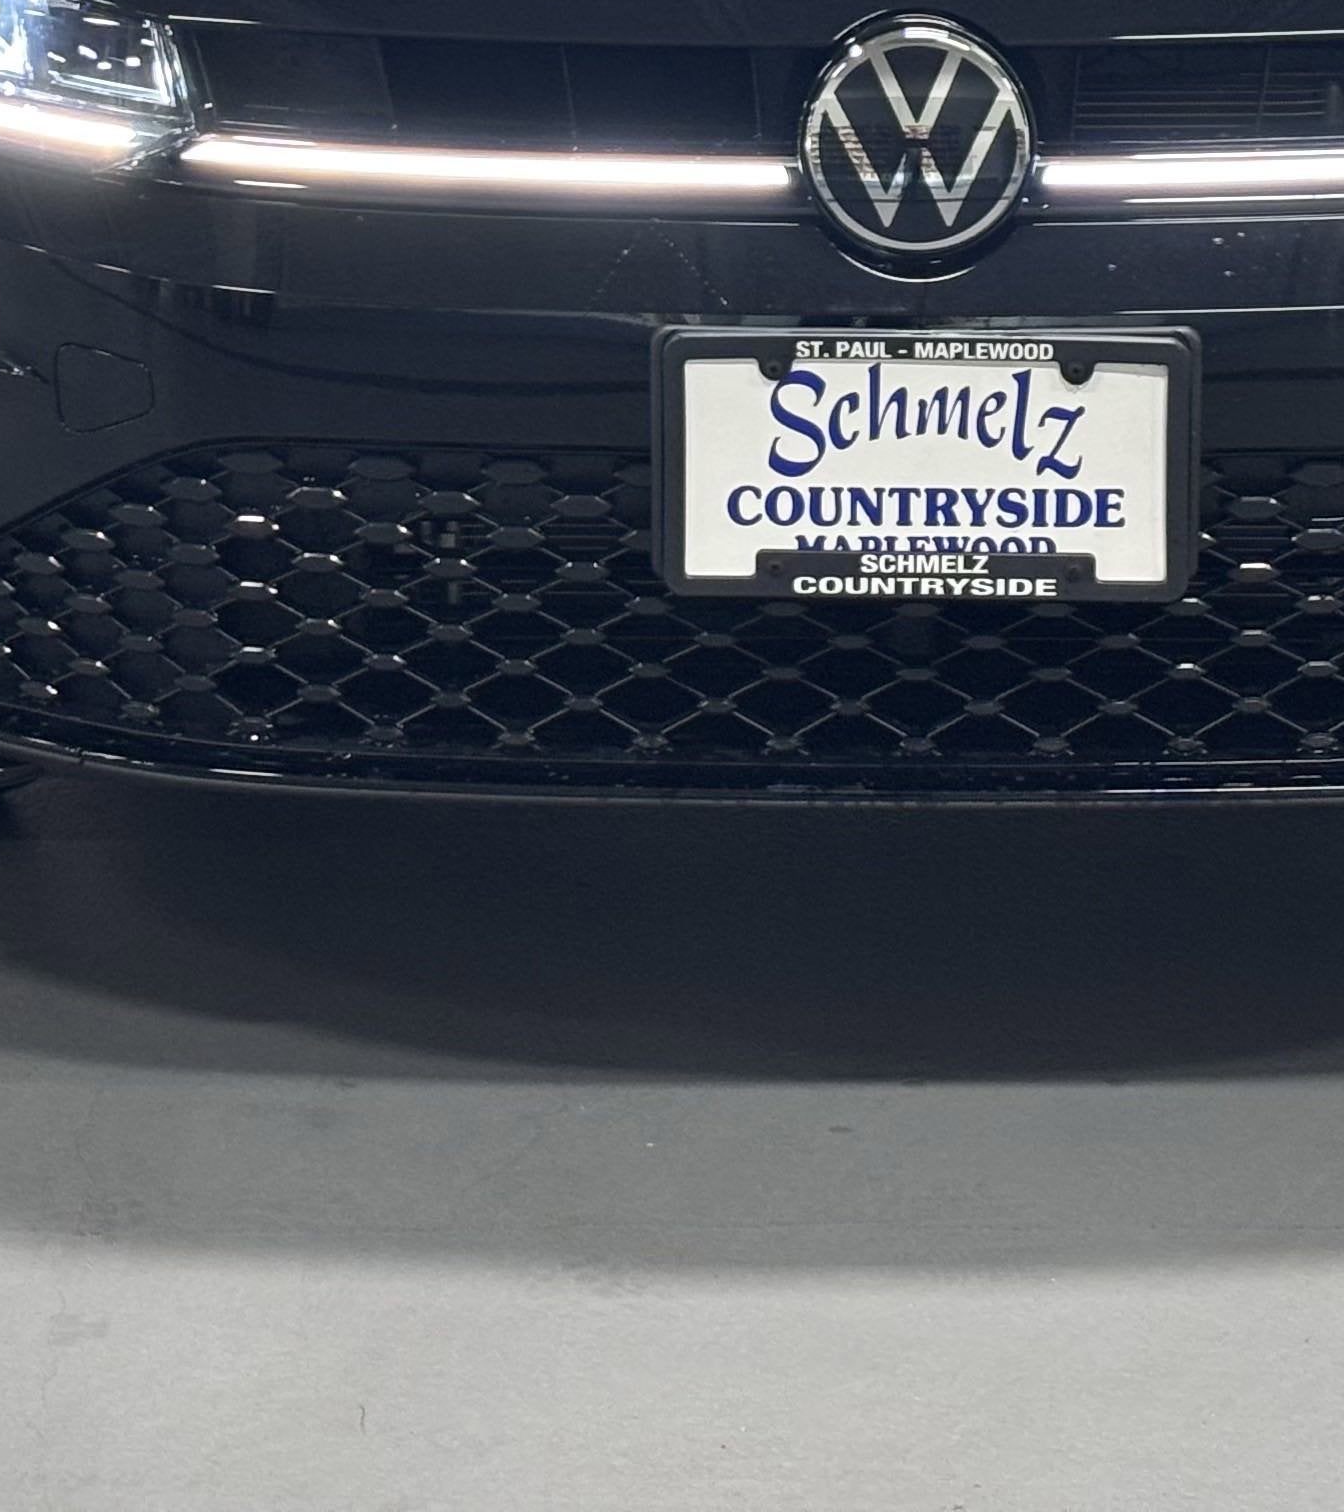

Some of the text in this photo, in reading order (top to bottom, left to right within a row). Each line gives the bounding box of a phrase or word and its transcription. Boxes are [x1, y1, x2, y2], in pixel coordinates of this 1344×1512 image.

[808, 28, 1027, 250] VW
[796, 340, 829, 358] ST.
[836, 340, 892, 359] PAUL
[914, 341, 1054, 360] MAPLEWOOD
[768, 362, 1086, 479] Schmelz
[726, 485, 1126, 529] COUNTRYSIDE
[860, 554, 989, 574] SCHMELZ
[793, 576, 1058, 596] COUNTRYSIDE
